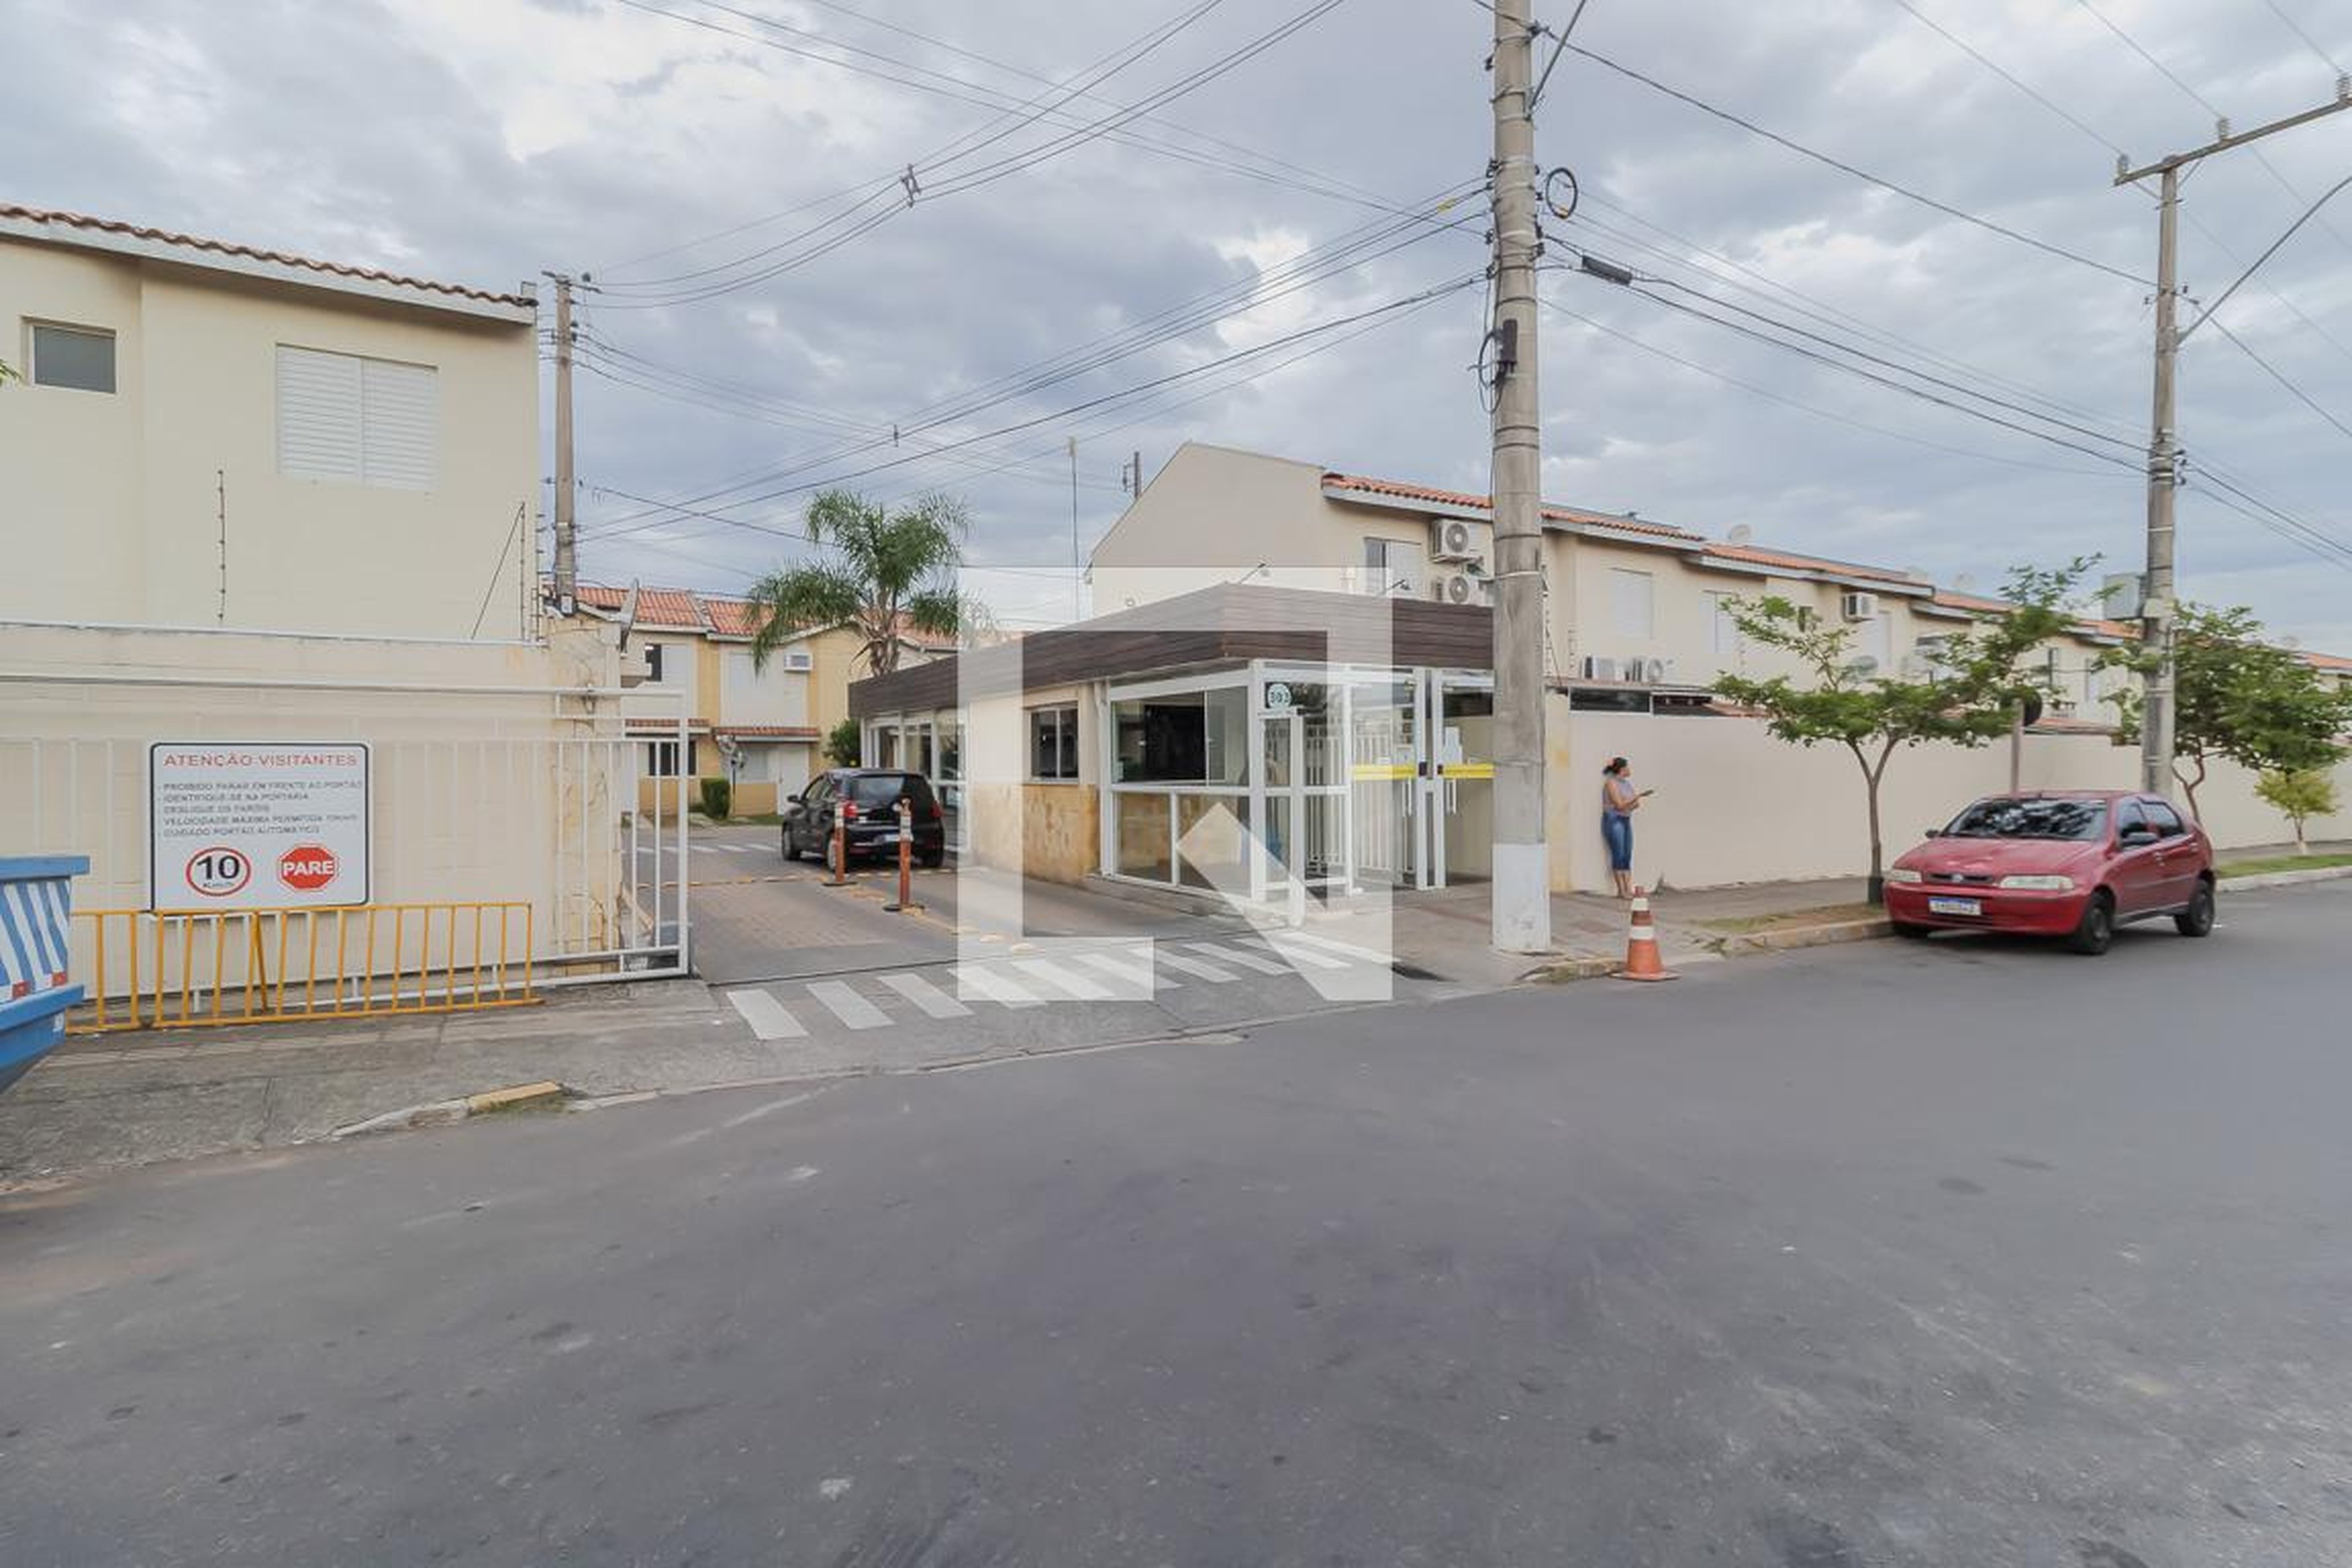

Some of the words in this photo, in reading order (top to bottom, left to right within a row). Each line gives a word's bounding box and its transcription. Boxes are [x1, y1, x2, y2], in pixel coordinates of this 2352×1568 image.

[164, 751, 252, 767] ATENÇÃO
[258, 753, 357, 766] VISITANTES
[196, 855, 241, 880] 10
[283, 859, 334, 876] PARE
